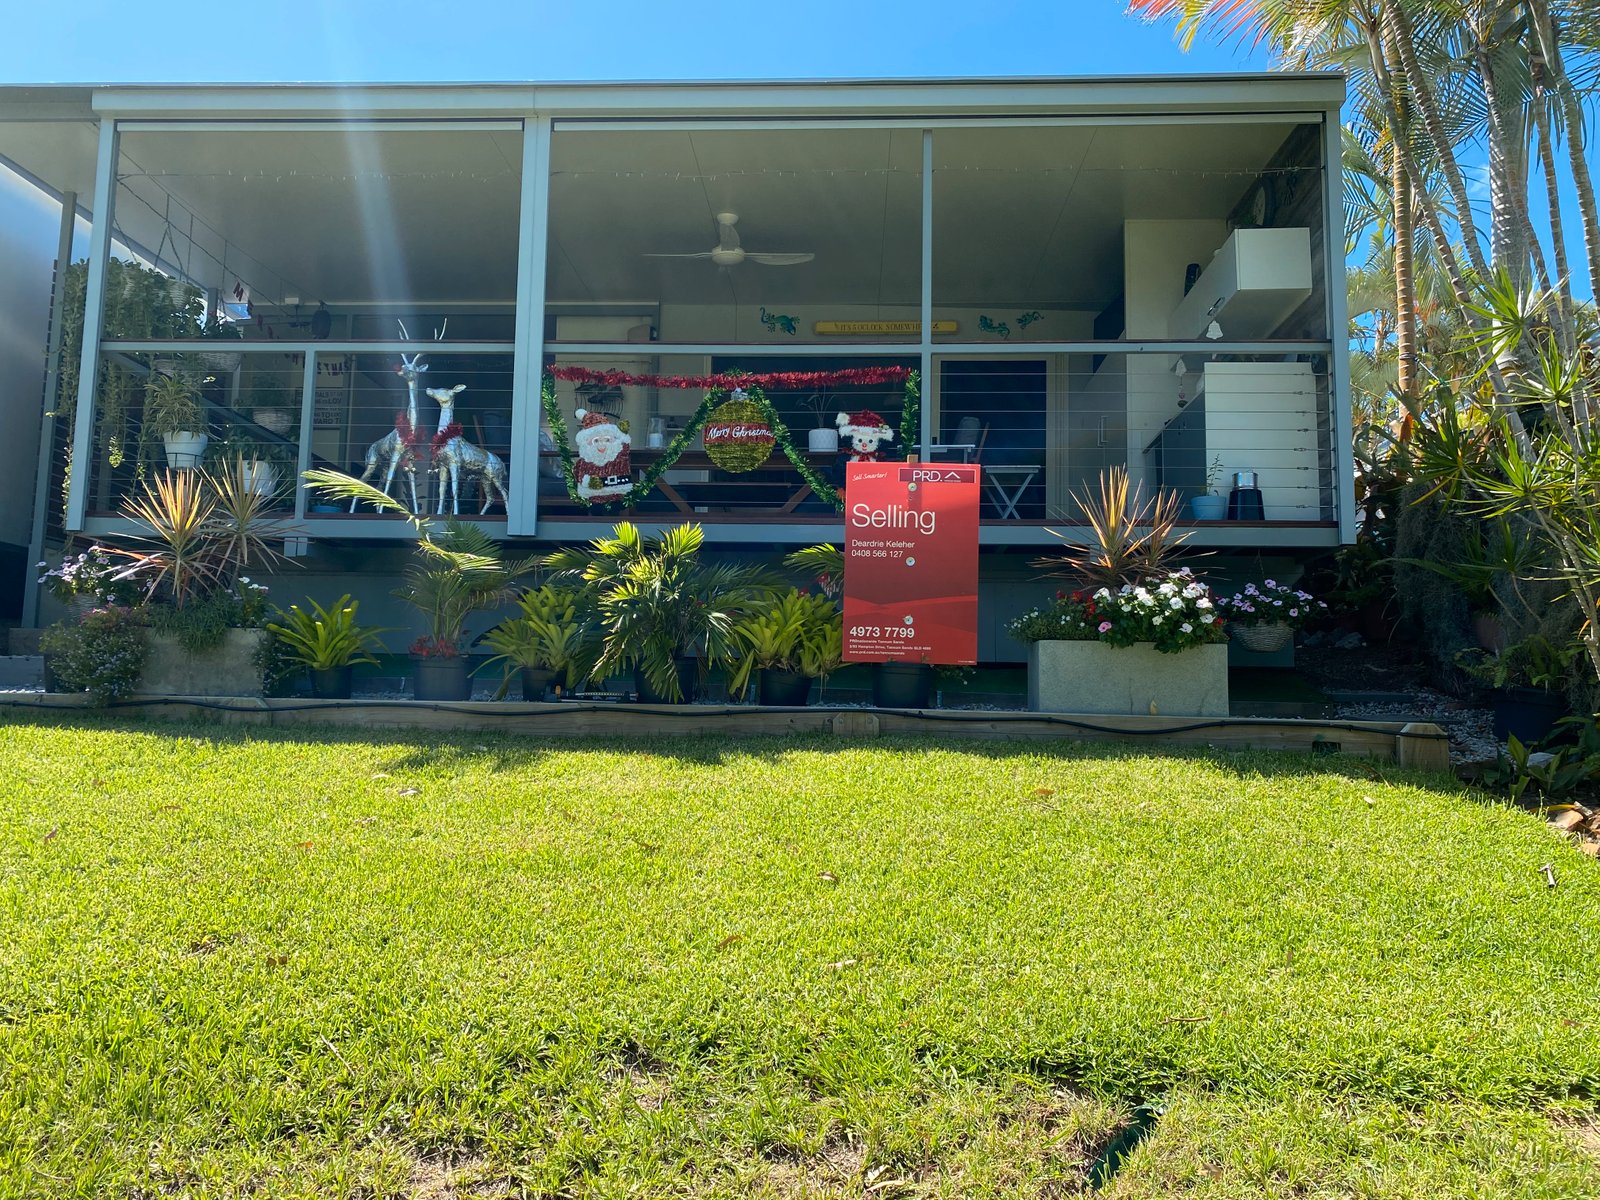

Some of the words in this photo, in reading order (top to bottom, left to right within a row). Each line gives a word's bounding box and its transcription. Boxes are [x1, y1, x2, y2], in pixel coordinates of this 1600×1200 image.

[706, 427, 731, 440] Merry
[852, 473, 862, 481] Sell
[863, 471, 888, 479] Smarter!
[852, 503, 936, 535] Selling
[851, 539, 884, 548] Deardrie
[886, 540, 915, 549] Keleher
[872, 550, 887, 558] 566
[889, 550, 904, 558] 127
[849, 626, 881, 637] 4973
[884, 627, 915, 638] 7799
